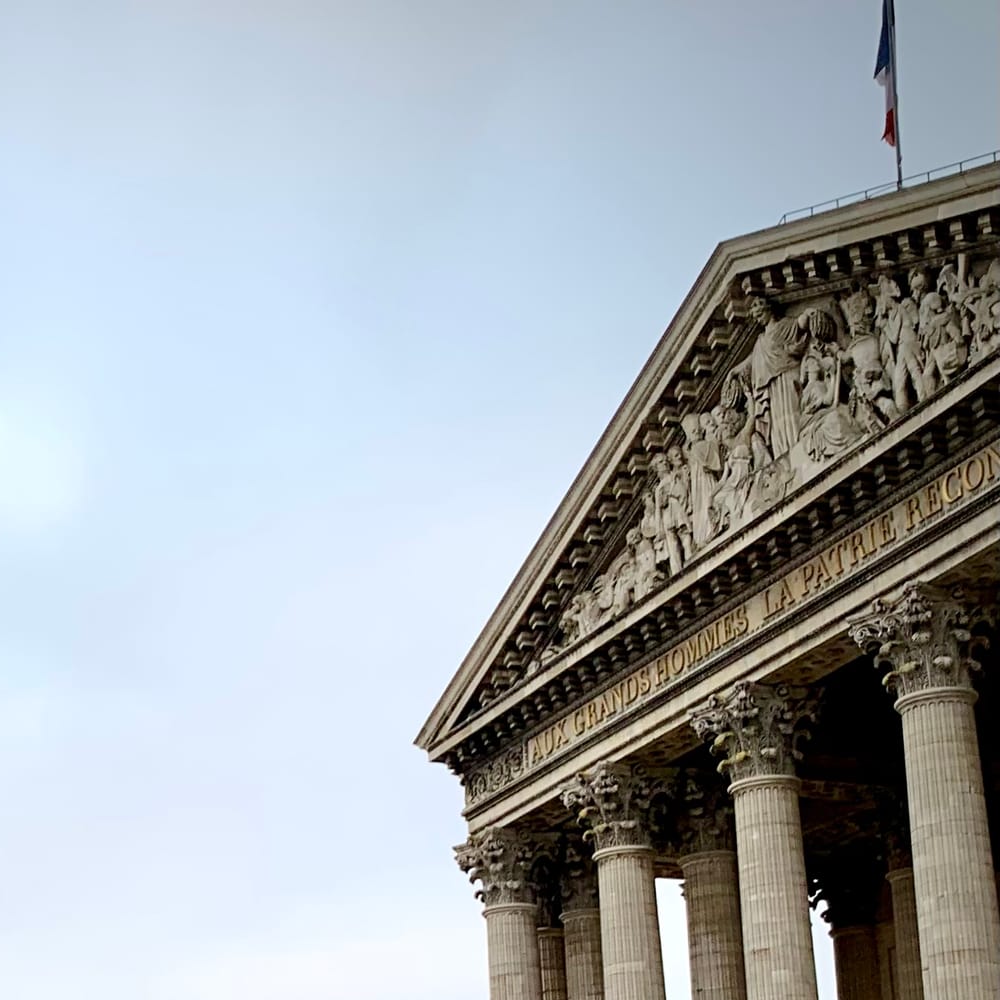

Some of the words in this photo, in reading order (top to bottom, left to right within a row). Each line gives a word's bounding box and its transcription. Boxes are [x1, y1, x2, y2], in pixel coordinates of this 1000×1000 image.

[531, 718, 569, 764] AUX
[572, 667, 651, 737] GRANDS
[654, 604, 749, 687] HOMMES
[763, 579, 796, 621] LA
[801, 510, 897, 597] PATRIE
